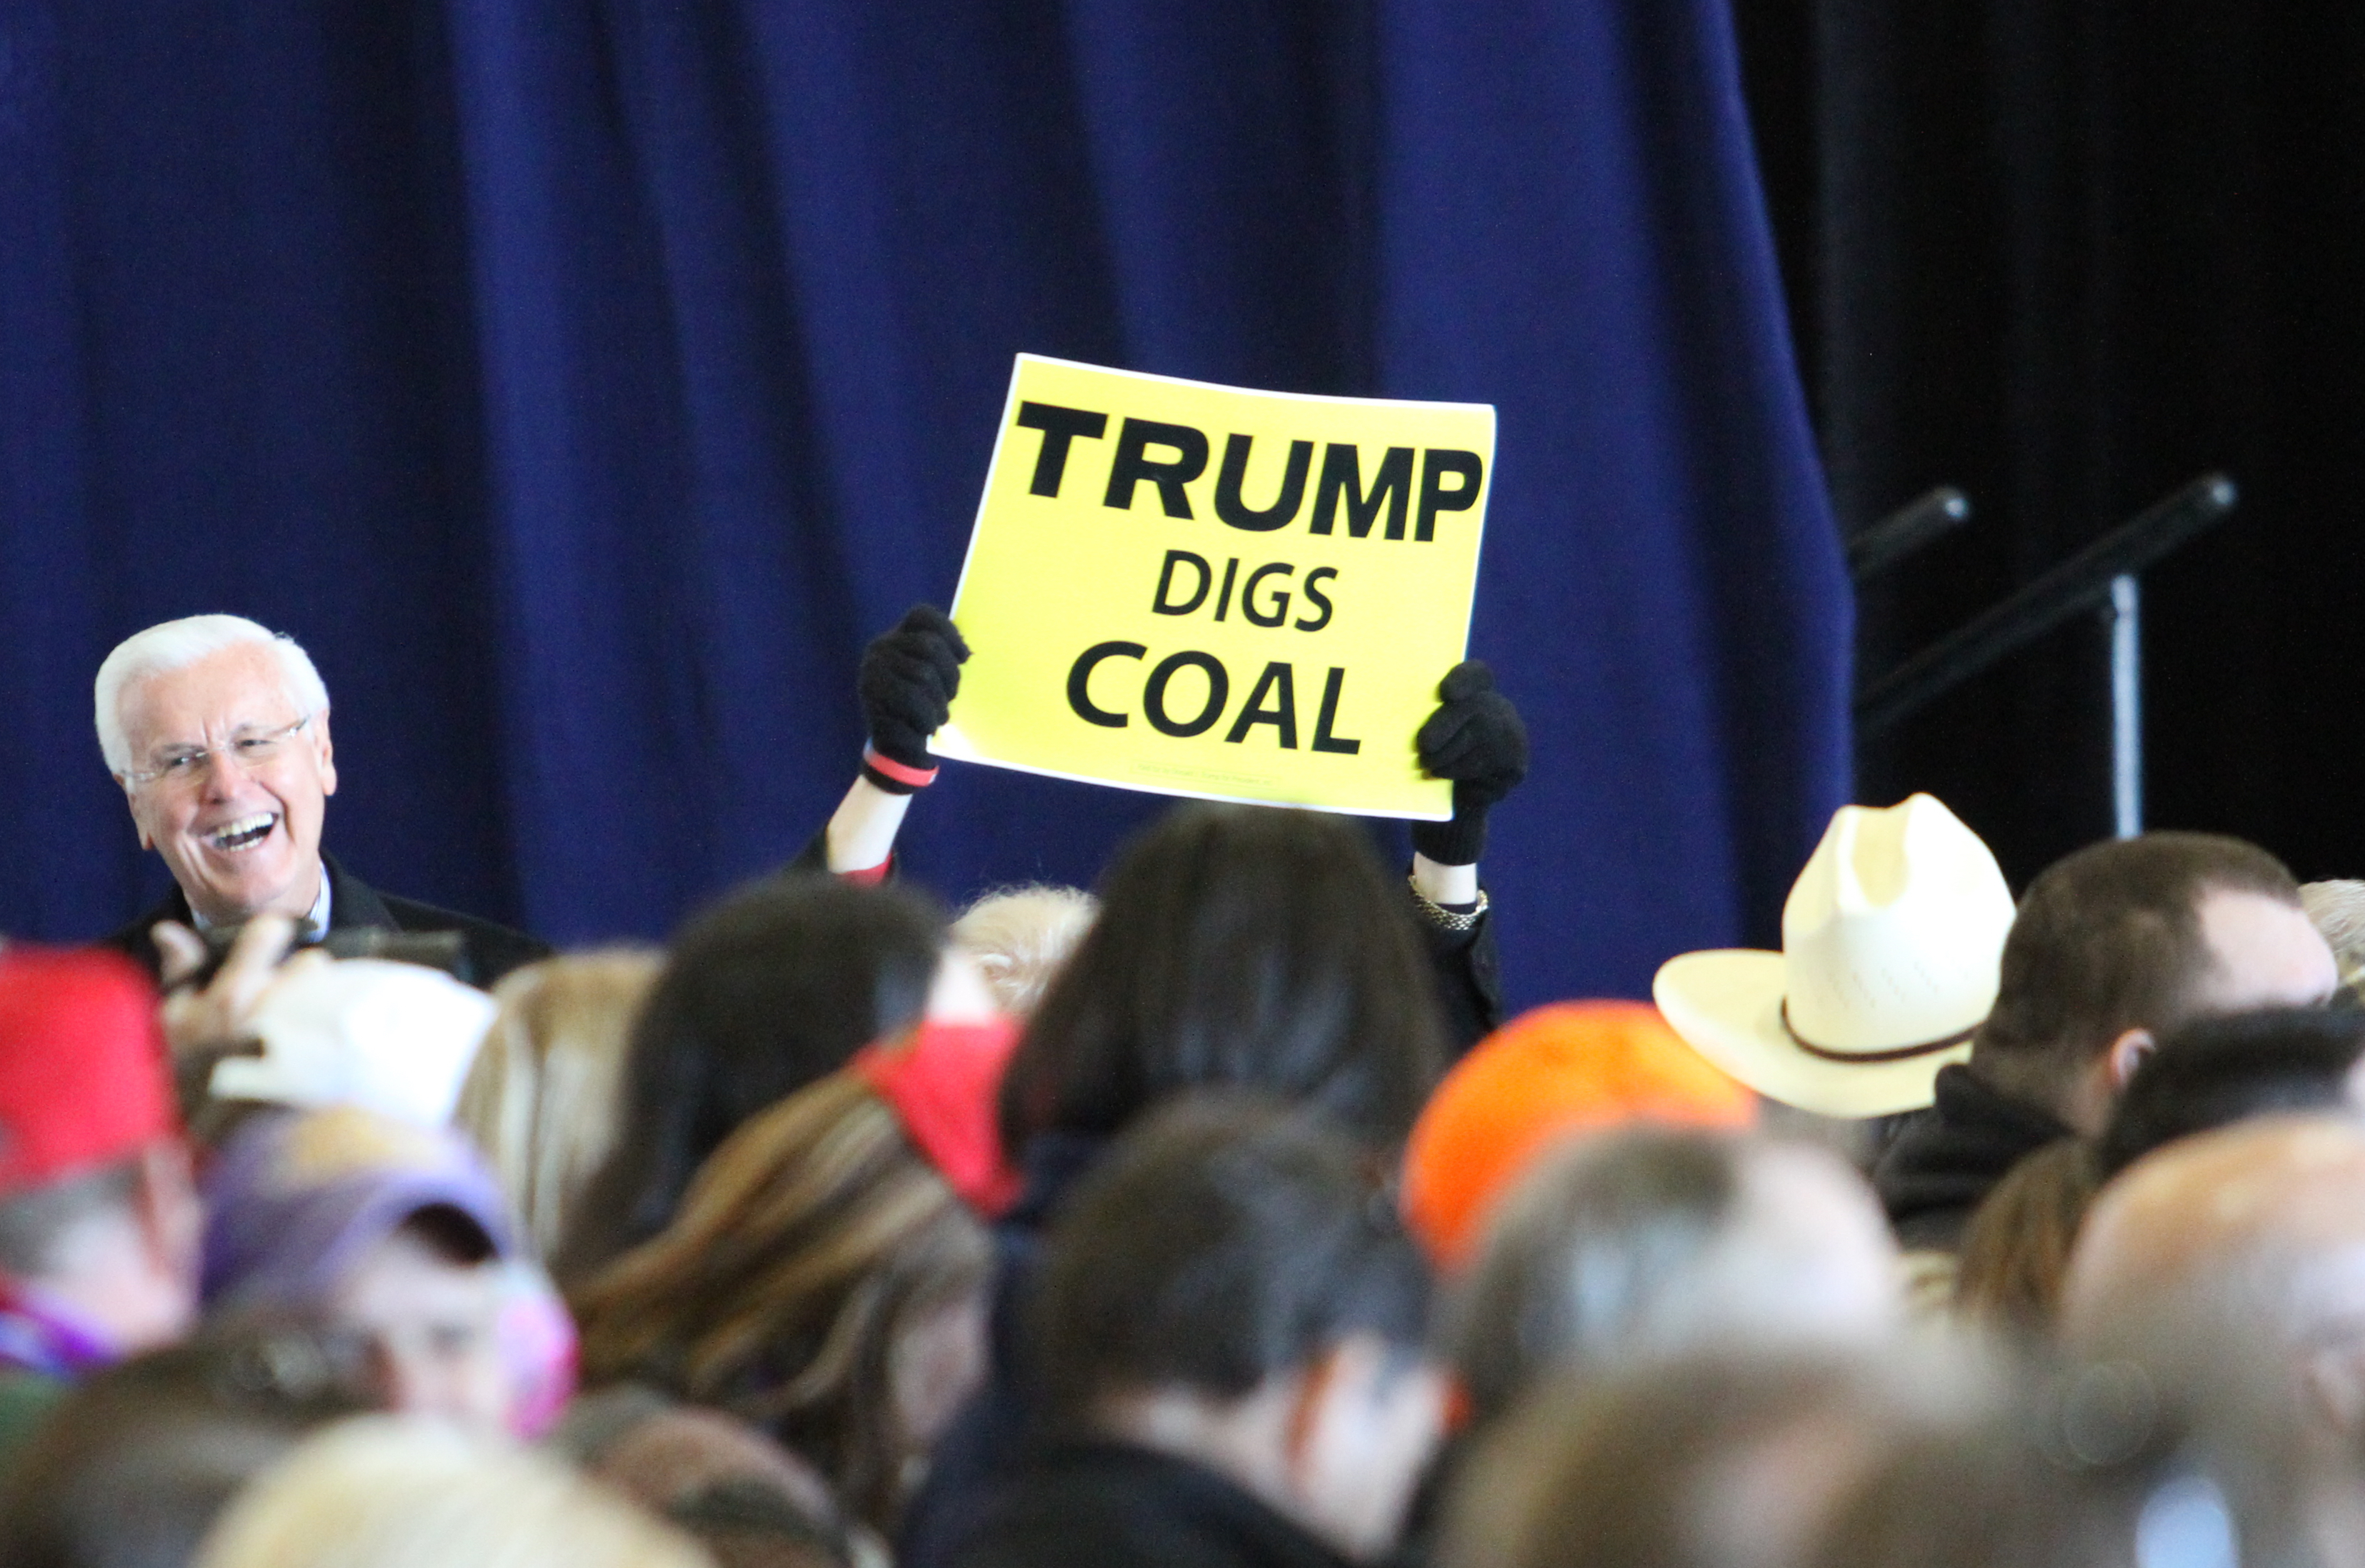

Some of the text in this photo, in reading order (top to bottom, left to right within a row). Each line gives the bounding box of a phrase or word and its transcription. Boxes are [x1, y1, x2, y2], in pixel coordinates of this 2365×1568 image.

[1016, 401, 1483, 541] TRUMP
[1152, 549, 1338, 632] DIGS
[1066, 641, 1361, 755] COAL
